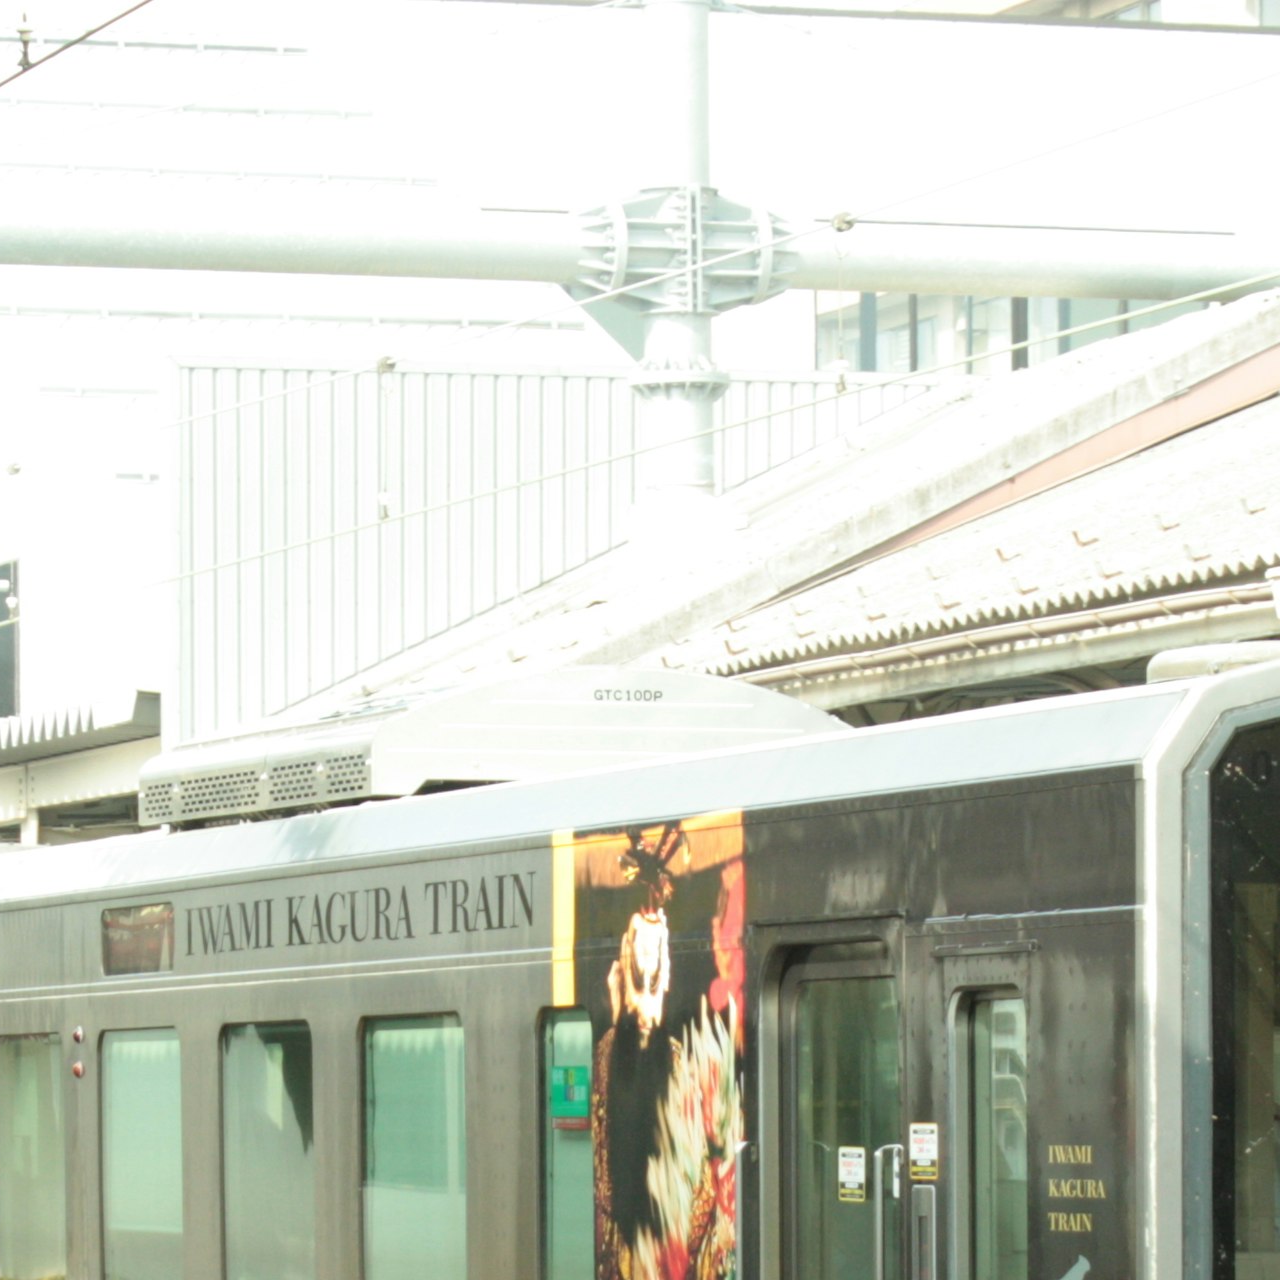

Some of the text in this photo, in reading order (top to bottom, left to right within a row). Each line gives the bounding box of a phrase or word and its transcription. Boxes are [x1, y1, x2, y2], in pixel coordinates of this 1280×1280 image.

[594, 689, 663, 701] GTC10DP
[185, 871, 536, 956] IWAMI KAGURA TRAIN
[1049, 1145, 1092, 1164] IWAMI
[1049, 1178, 1106, 1198] KAGURA
[1048, 1211, 1092, 1232] TRAIN
